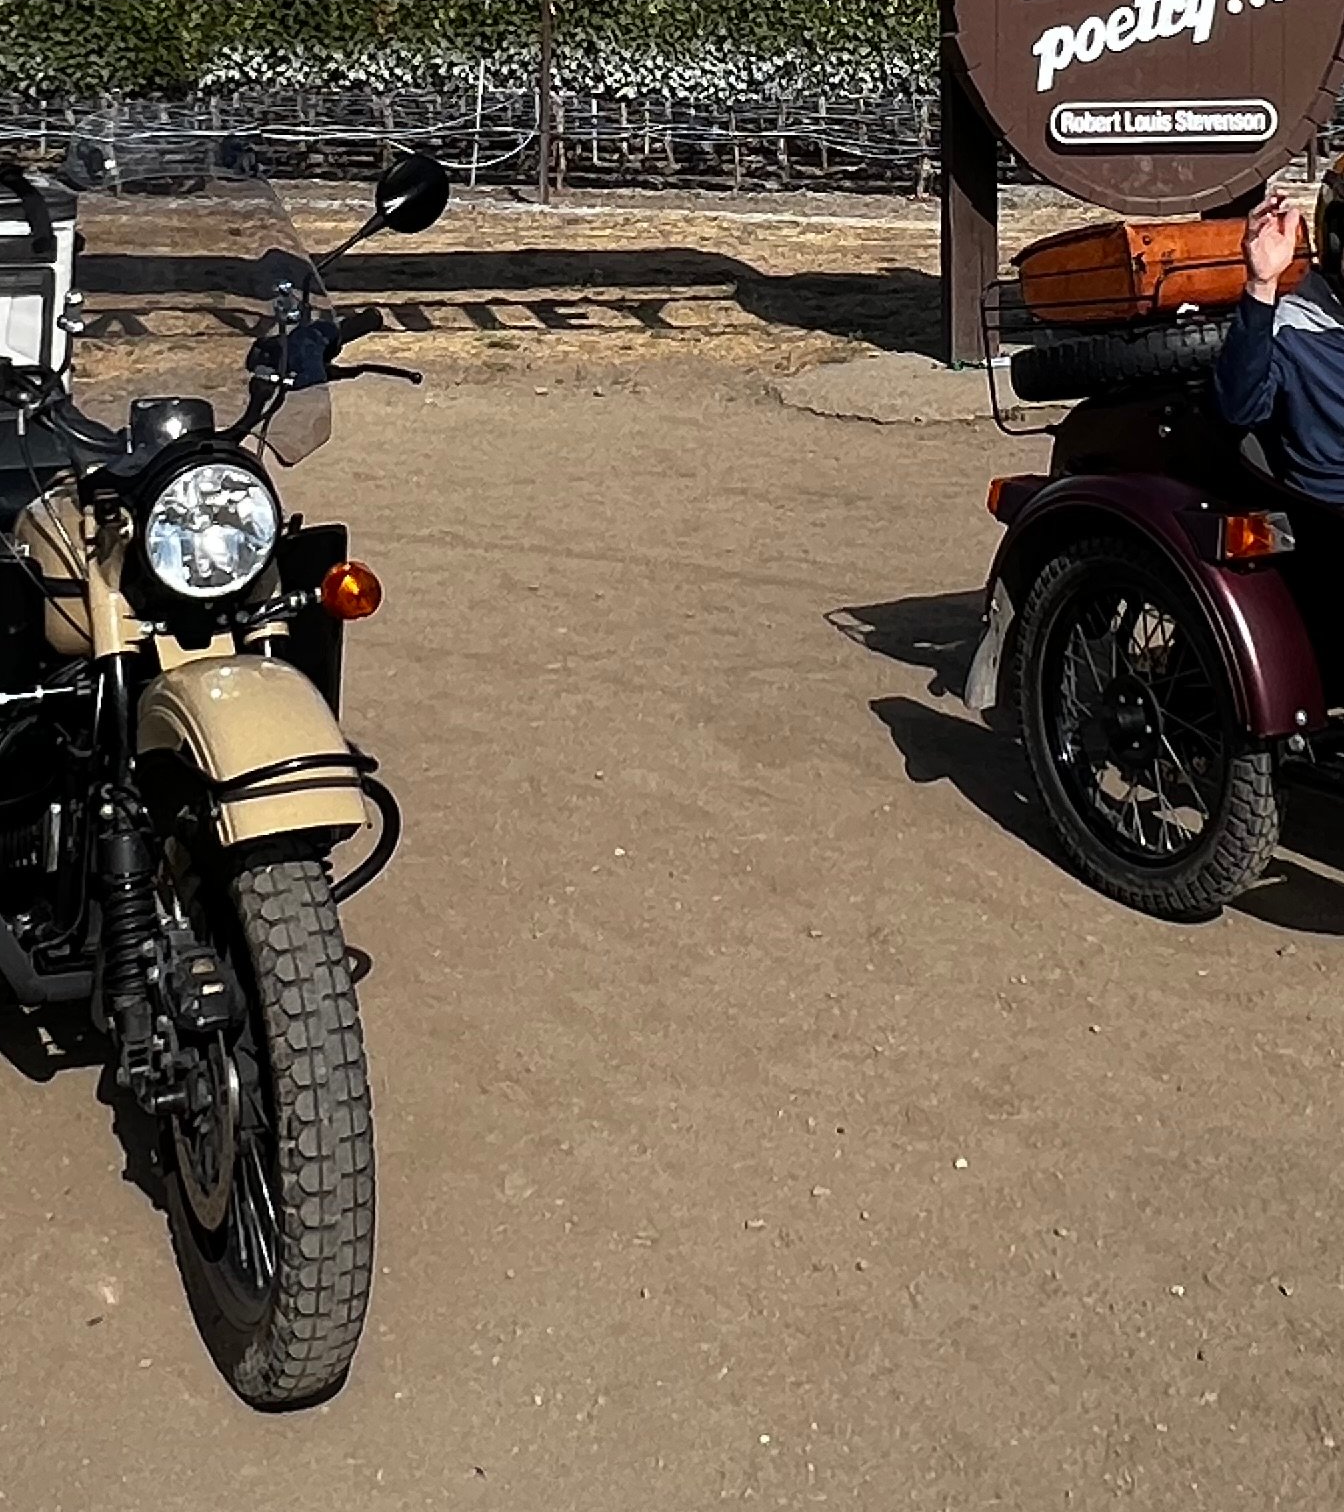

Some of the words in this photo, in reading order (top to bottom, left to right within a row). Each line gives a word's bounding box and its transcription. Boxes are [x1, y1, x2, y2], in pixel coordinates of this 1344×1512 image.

[1060, 110, 1121, 134] Robert
[1124, 110, 1172, 133] Louis
[1174, 109, 1266, 133] Stevenson
